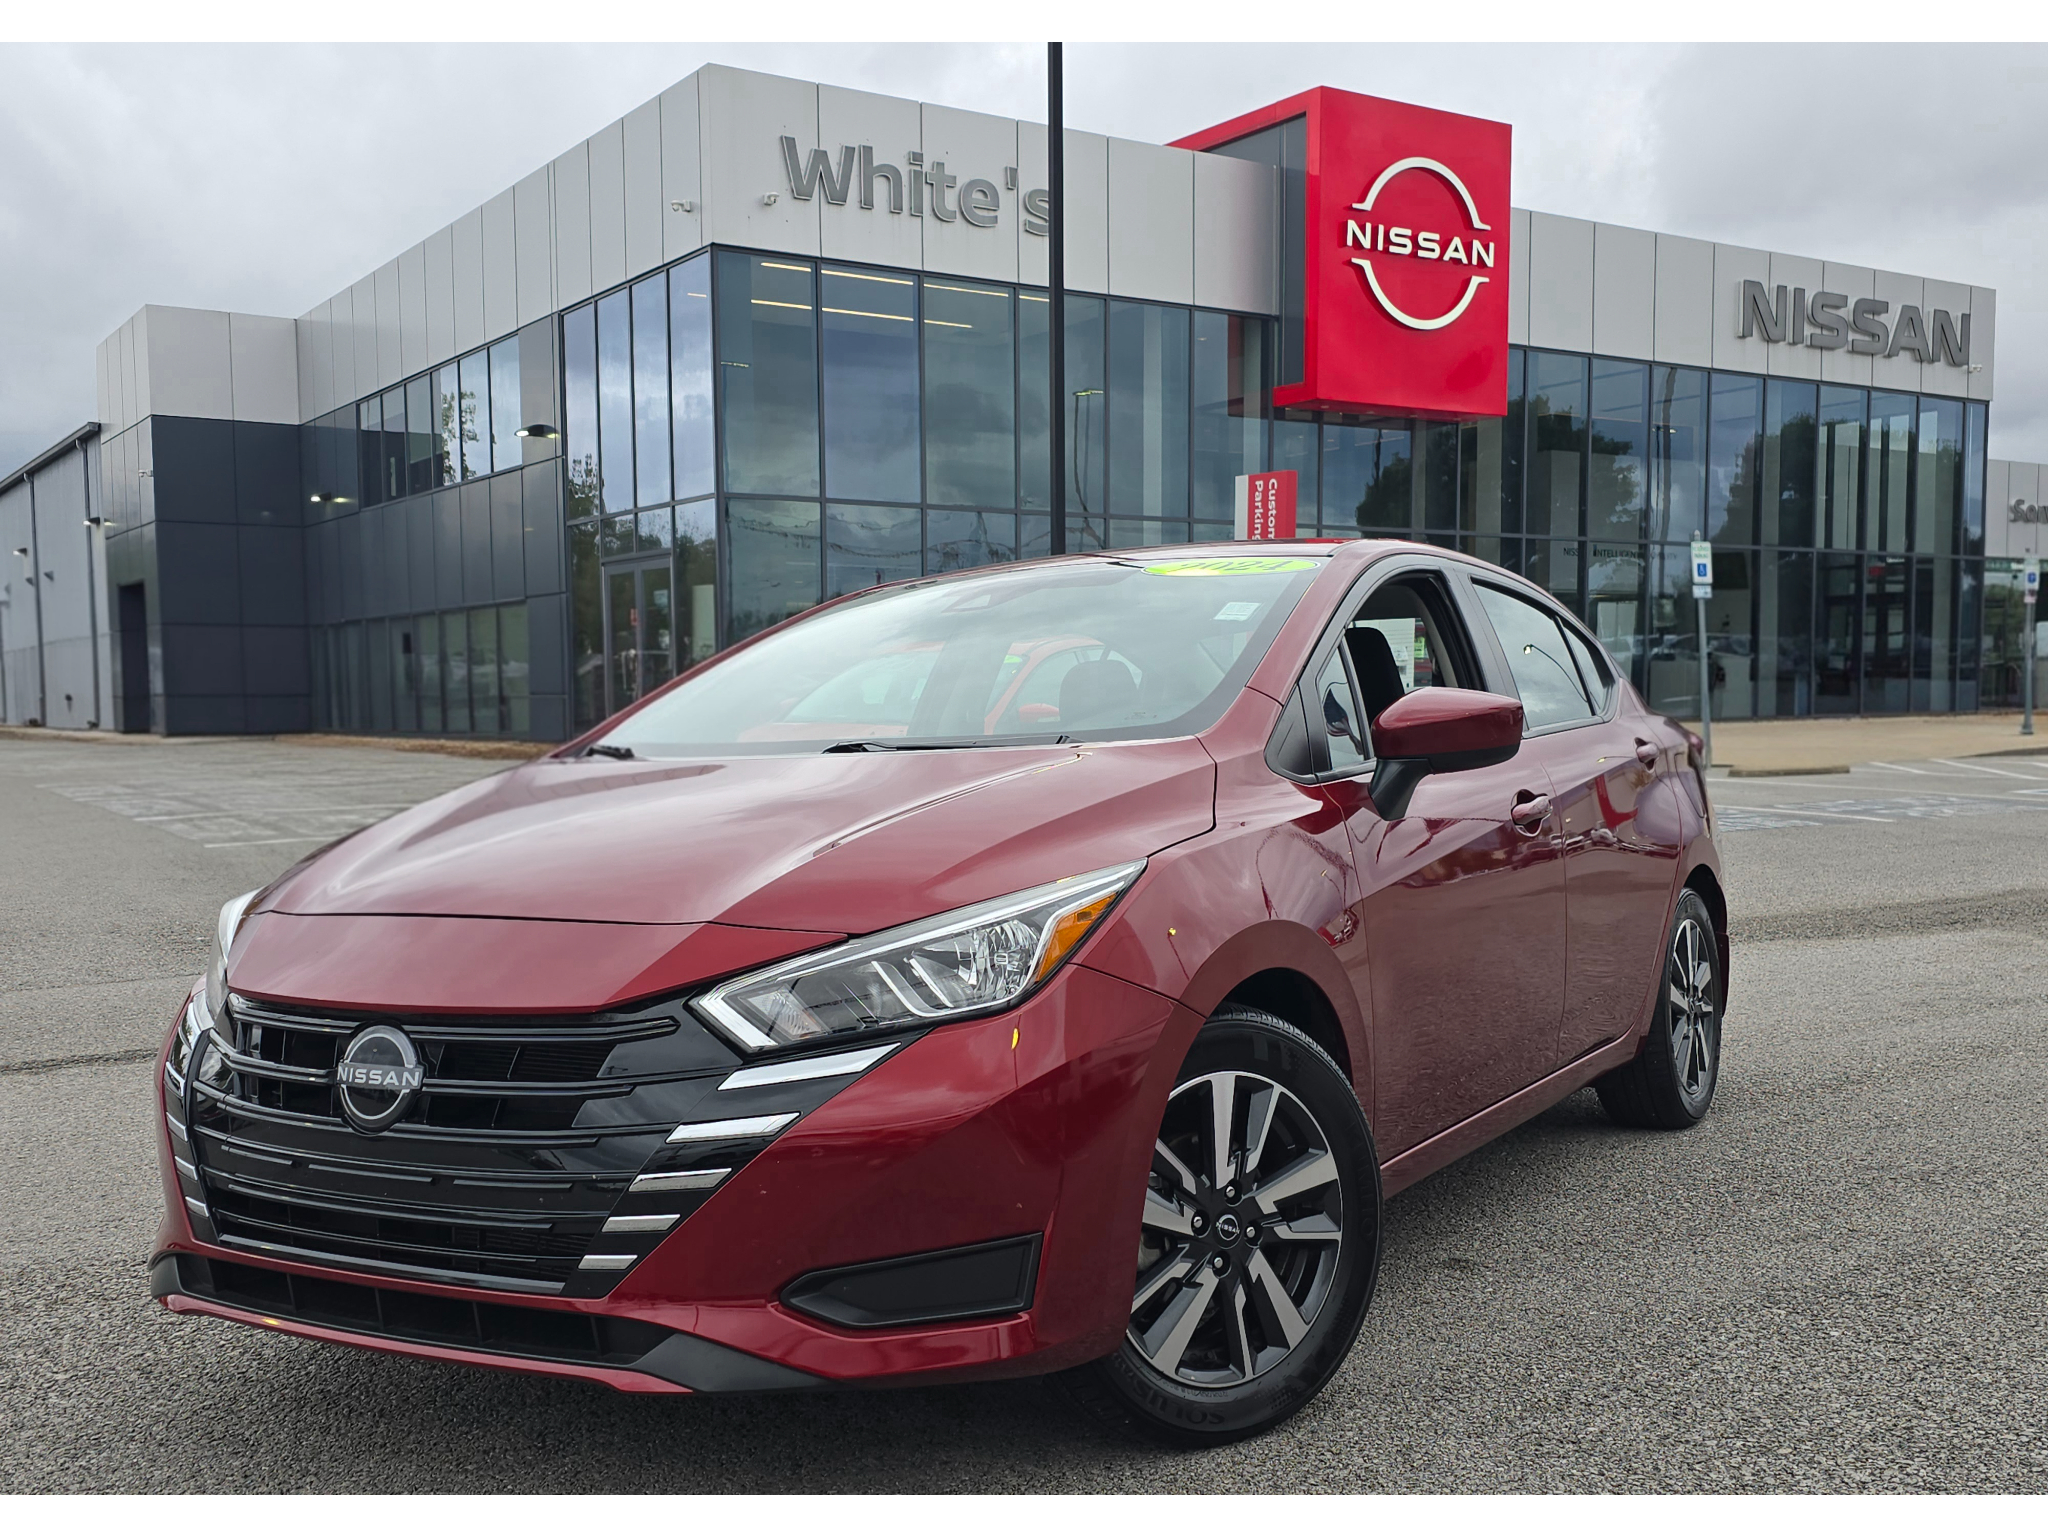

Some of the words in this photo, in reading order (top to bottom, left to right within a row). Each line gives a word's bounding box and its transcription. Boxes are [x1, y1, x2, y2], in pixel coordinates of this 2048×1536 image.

[780, 135, 1049, 236] White's
[1346, 219, 1495, 268] NISSAN
[1740, 279, 1971, 367] NISSAN
[337, 1065, 420, 1087] NISSAN
